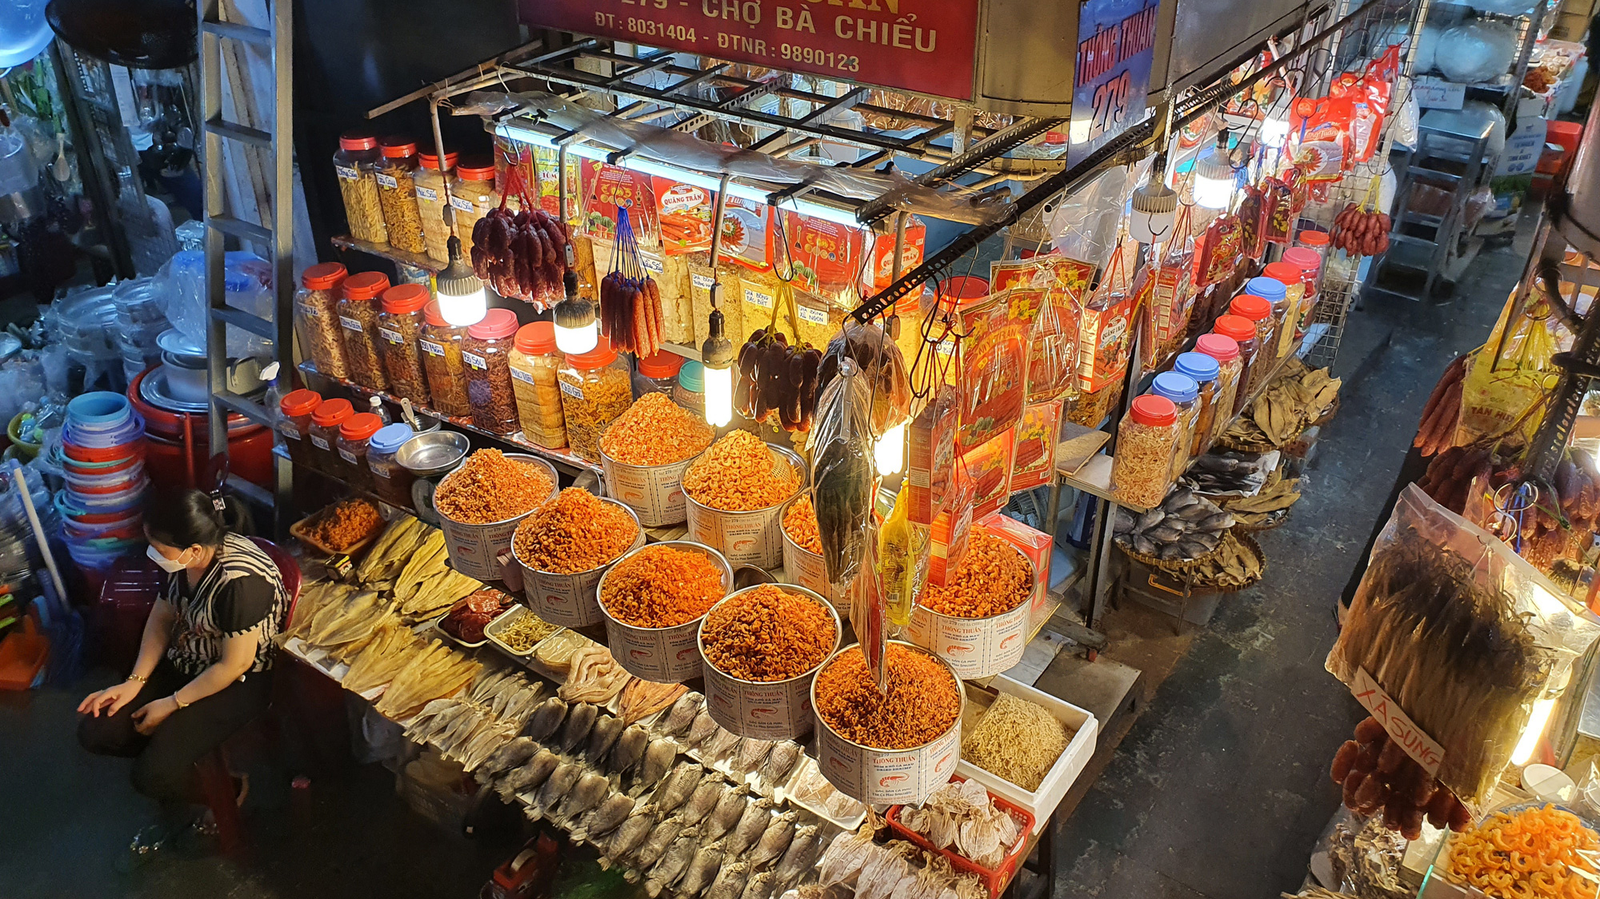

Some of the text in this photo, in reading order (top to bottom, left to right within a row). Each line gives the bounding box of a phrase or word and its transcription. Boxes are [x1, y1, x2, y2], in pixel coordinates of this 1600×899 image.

[628, 17, 697, 43] 8031404
[780, 43, 860, 73] 9890123
[702, 0, 762, 29] CHỢ
[776, 4, 816, 34] BÀ
[835, 13, 937, 53] CHIỂU
[1088, 69, 1132, 142] 279
